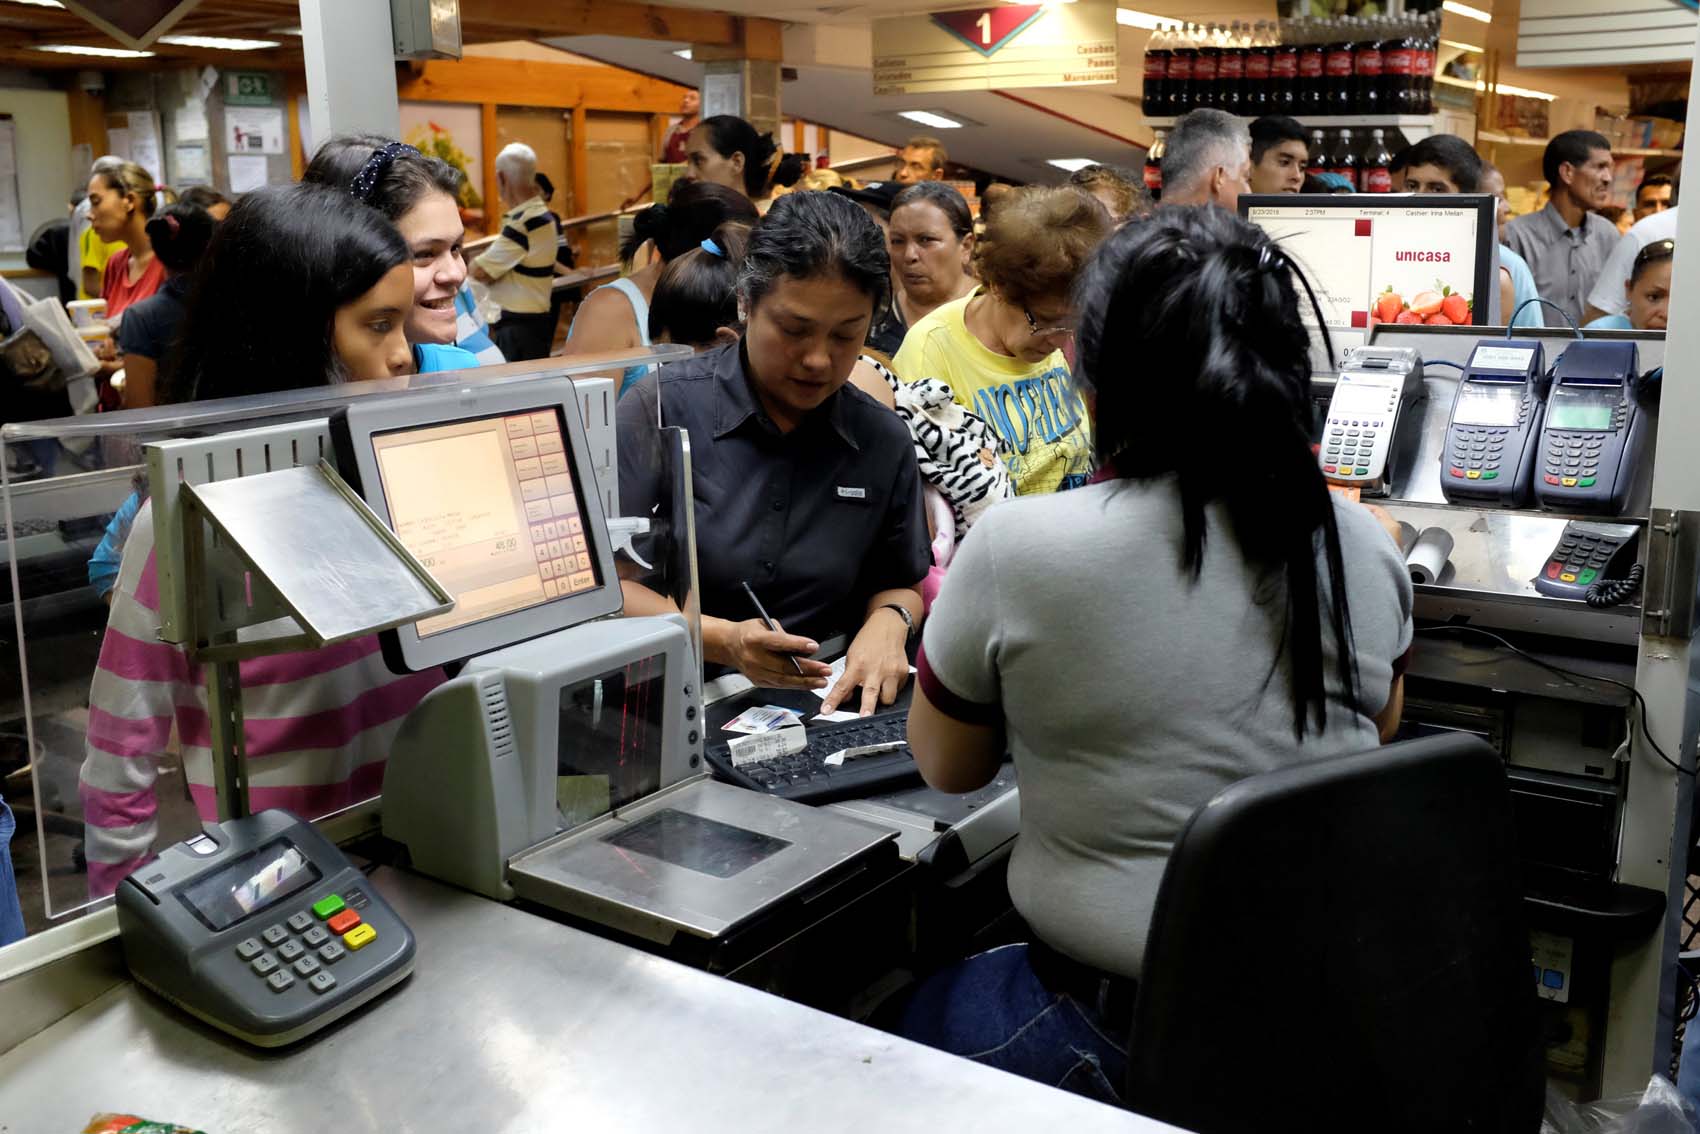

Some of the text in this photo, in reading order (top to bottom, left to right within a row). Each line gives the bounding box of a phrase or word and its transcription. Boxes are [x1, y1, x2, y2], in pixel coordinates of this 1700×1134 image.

[976, 12, 992, 44] 1
[1395, 250, 1451, 263] unicasa
[270, 927, 279, 937] 2
[296, 914, 304, 923] 3
[260, 929, 320, 965] 4 5 6
[274, 945, 335, 983] 7 8 9
[318, 975, 327, 983] 0
